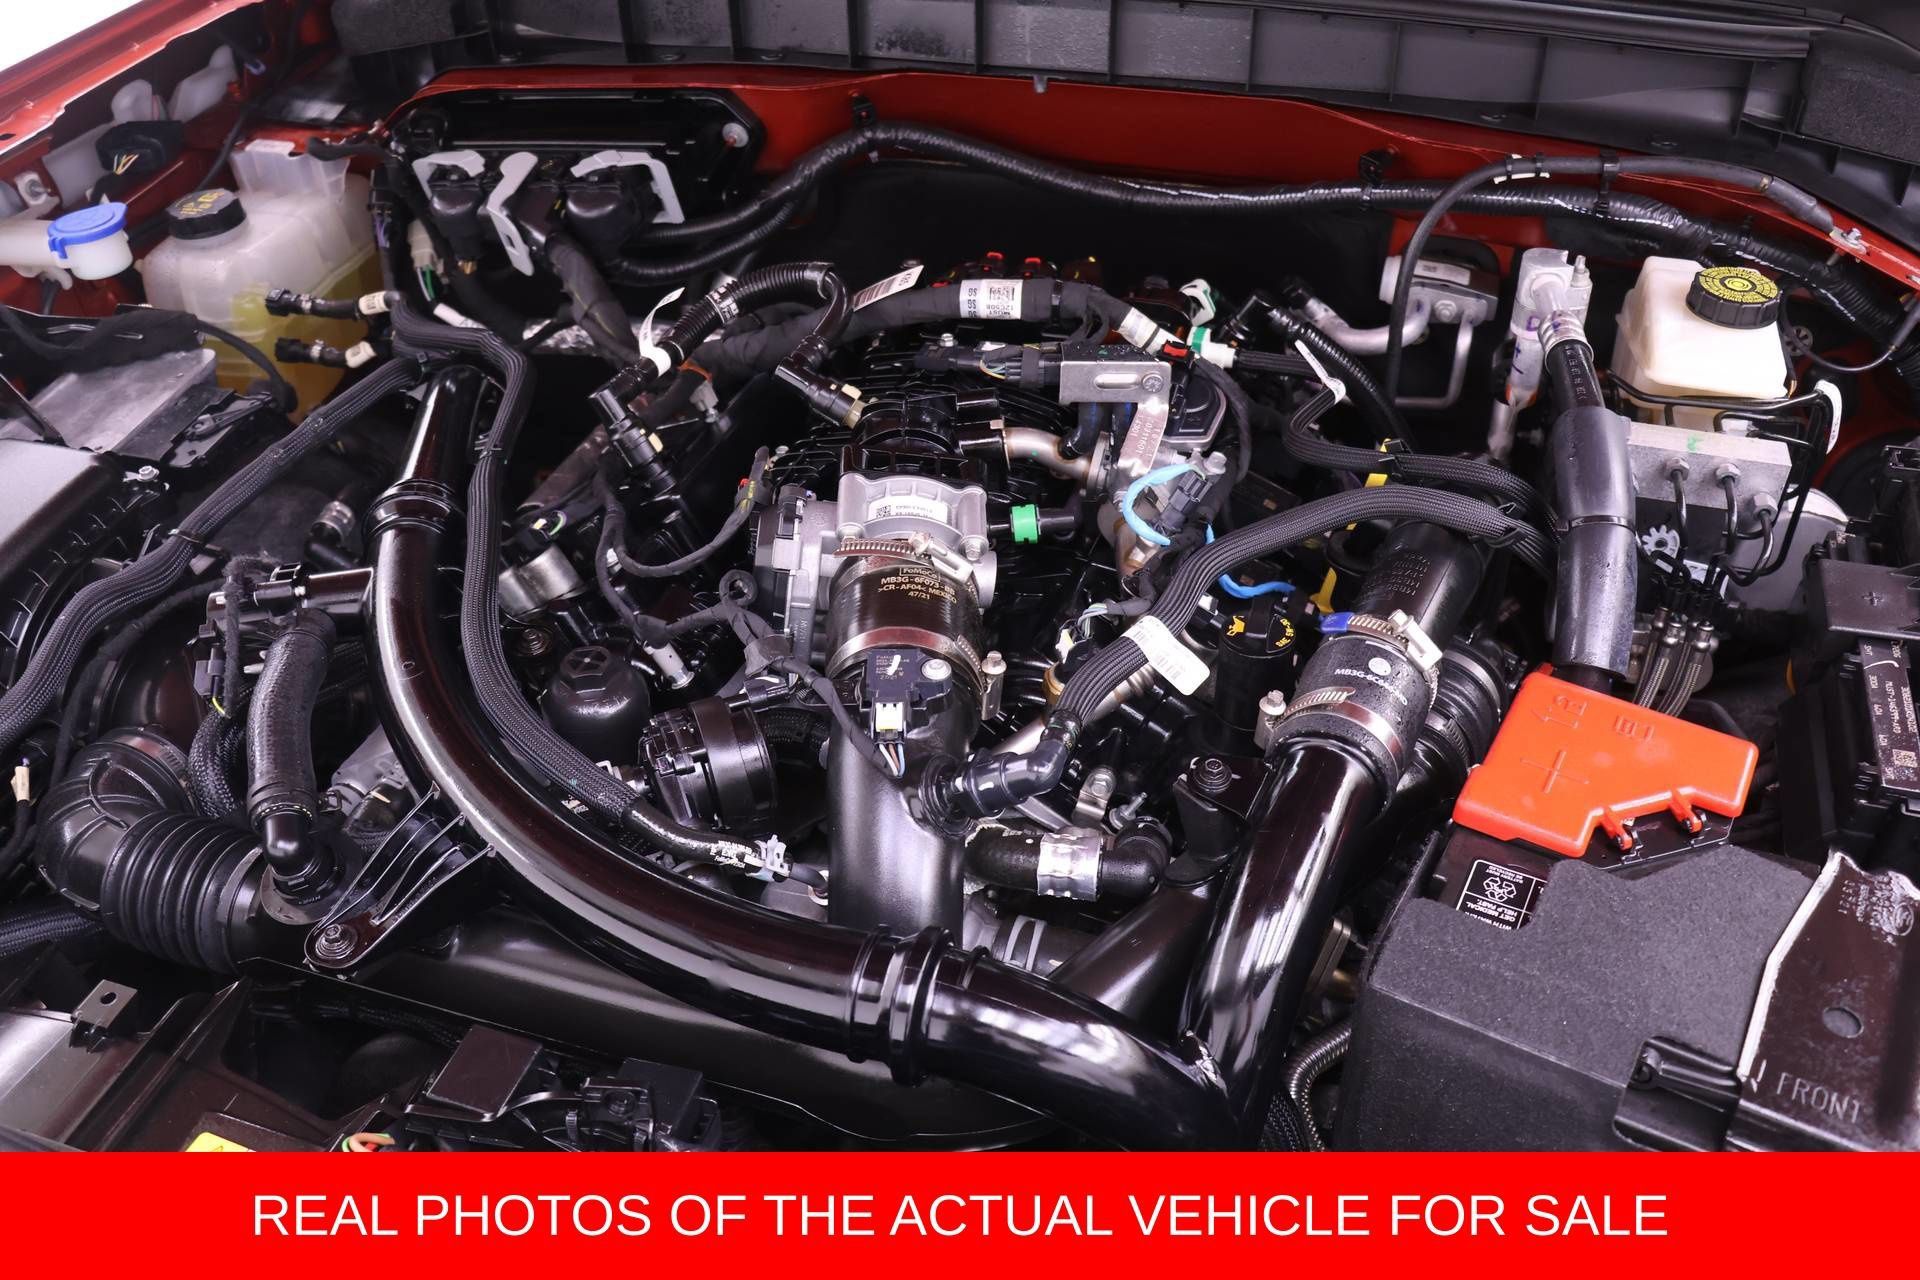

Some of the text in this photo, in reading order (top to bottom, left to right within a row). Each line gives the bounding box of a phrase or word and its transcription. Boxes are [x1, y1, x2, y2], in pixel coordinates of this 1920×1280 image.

[1466, 901, 1499, 918] MEDICAL
[1477, 898, 1518, 917] HELP FAST.
[1499, 913, 1516, 922] GET
[1776, 1071, 1860, 1125] FRONT
